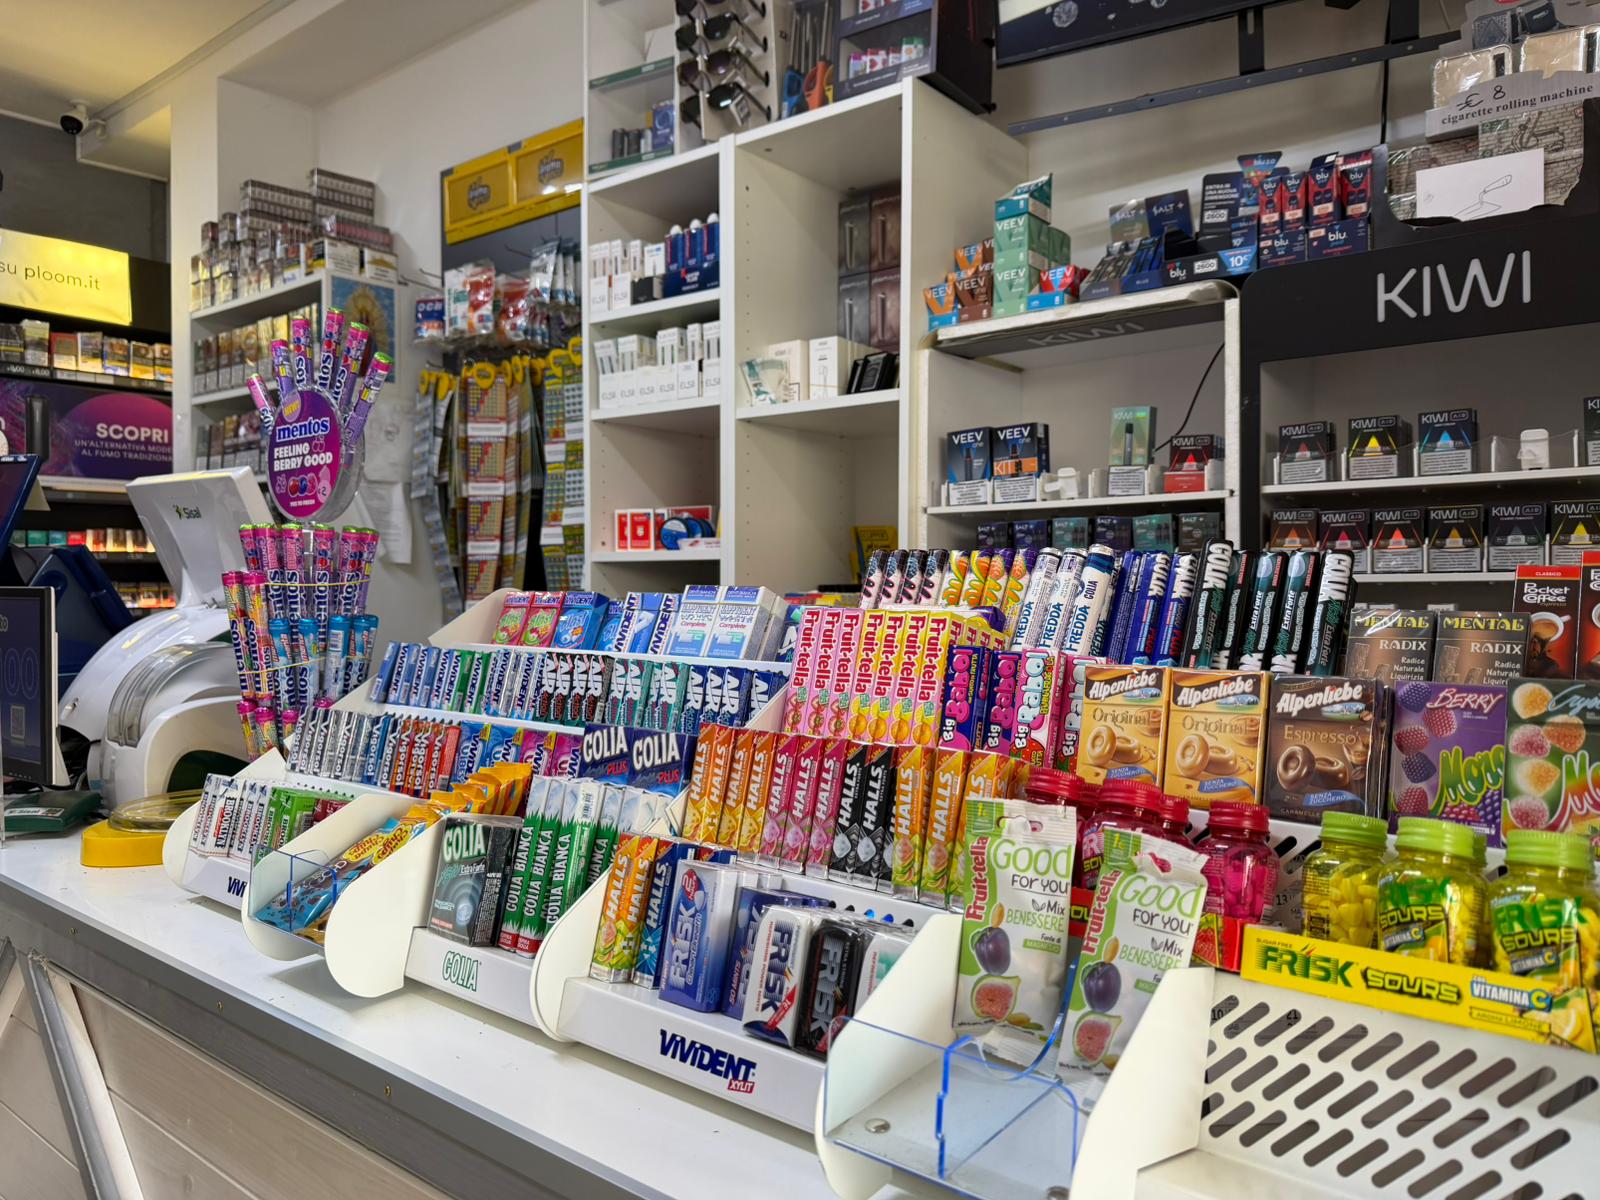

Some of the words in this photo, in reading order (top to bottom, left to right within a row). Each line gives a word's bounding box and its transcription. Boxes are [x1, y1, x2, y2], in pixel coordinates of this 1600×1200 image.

[1441, 106, 1493, 125] cigarette
[1496, 97, 1537, 113] rolling
[1540, 84, 1593, 104] machine
[1493, 85, 1506, 100] 8
[1286, 177, 1300, 186] blu
[1315, 172, 1329, 180] blu
[1350, 172, 1363, 180] blu
[996, 217, 1025, 231] VEEV
[1328, 230, 1347, 241] blu
[955, 243, 983, 257] VEEV
[1274, 239, 1289, 247] blu
[24, 265, 101, 291] ploom.it
[955, 277, 986, 291] VEEV
[996, 268, 1026, 281] VEEV
[1040, 265, 1073, 281] VEEV
[1169, 268, 1187, 279] blu
[1376, 250, 1532, 323] KIWI
[275, 417, 330, 442] mentos
[1281, 425, 1306, 436] KIWI
[1351, 418, 1377, 429] KIWI
[1421, 412, 1448, 425] KIWI
[96, 423, 169, 444] SCOPRI
[952, 430, 984, 445] VEEV
[998, 426, 1031, 441] VEEV
[81, 449, 93, 457] AL
[95, 450, 121, 459] FUMO
[273, 442, 310, 459] FEELING
[273, 457, 303, 472] BERRY
[304, 452, 333, 467] GOOD
[1321, 512, 1347, 523] KIWI
[1375, 510, 1401, 521] KIWI
[1430, 509, 1458, 520] KIWI
[1491, 506, 1521, 517] KIWI
[1554, 503, 1584, 514] KIWI
[1522, 593, 1567, 604] Coffee
[1523, 582, 1571, 595] Pocket
[286, 570, 300, 646] mentos
[314, 570, 329, 645] mentos
[1013, 601, 1035, 646] FREDDA
[1038, 602, 1064, 648] FREDDA
[1065, 604, 1091, 652] FREDDA
[1443, 615, 1525, 632] MENTAL
[230, 619, 248, 692] mentos
[247, 618, 262, 693] mentos
[1379, 639, 1427, 651] RADIX
[1471, 642, 1523, 655] RADIX
[1393, 664, 1425, 673] Naturale
[1401, 656, 1425, 665] Radice
[1494, 660, 1521, 669] Radice
[1390, 672, 1424, 681] Liquirizia
[1486, 668, 1521, 678] Naturale
[945, 649, 973, 724] Babol
[991, 654, 1019, 730] Babol
[1017, 652, 1049, 724] Babol
[1088, 671, 1159, 701] Alpenliebe
[1177, 677, 1255, 708] Alpenliebe
[1276, 685, 1363, 717] Alpenliebe
[1426, 688, 1504, 713] BERRY
[943, 719, 956, 741] Big
[1092, 707, 1150, 731] Original
[1182, 714, 1249, 741] Original
[583, 726, 628, 763] GOLIA
[988, 724, 1001, 748] Big
[1014, 725, 1029, 748] Big
[1062, 732, 1077, 756] Big
[1284, 725, 1357, 745] Espresso
[633, 732, 680, 771] GOLIA
[607, 760, 628, 776] PLUS
[658, 769, 680, 785] PLUS
[690, 741, 709, 800] HALLS
[710, 744, 728, 803] HALLS
[727, 748, 746, 808] HALLS
[746, 751, 766, 811] HALLS
[769, 752, 788, 813] HALLS
[792, 756, 813, 819] HALLS
[816, 757, 837, 820] HALLS
[838, 762, 860, 827] HALLS
[215, 797, 236, 848] BROOKLYN
[443, 823, 487, 861] GOLIA
[514, 826, 534, 871] BIANCA
[552, 833, 571, 881] BIANCA
[524, 880, 541, 917] GOLIA
[533, 829, 553, 877] BIANCA
[506, 876, 524, 913] GOLIA
[546, 885, 563, 924] GOLIA
[1046, 899, 1065, 915] Mix
[1380, 906, 1445, 928] SOURS
[1494, 896, 1587, 933] FRISK
[1006, 908, 1065, 933] BENESSERE
[670, 902, 696, 989] FRISK
[1161, 939, 1184, 958] Mix
[1502, 928, 1577, 951] SOURS
[441, 950, 479, 993] GOLIA
[760, 920, 792, 1015] FRISK
[1258, 943, 1356, 988] FRISK
[810, 936, 842, 1037] FRISK
[1364, 970, 1460, 1004] SOURS
[1472, 981, 1530, 1007] VITAMINA
[1531, 990, 1548, 1008] C
[729, 1079, 755, 1093] XYLIT
